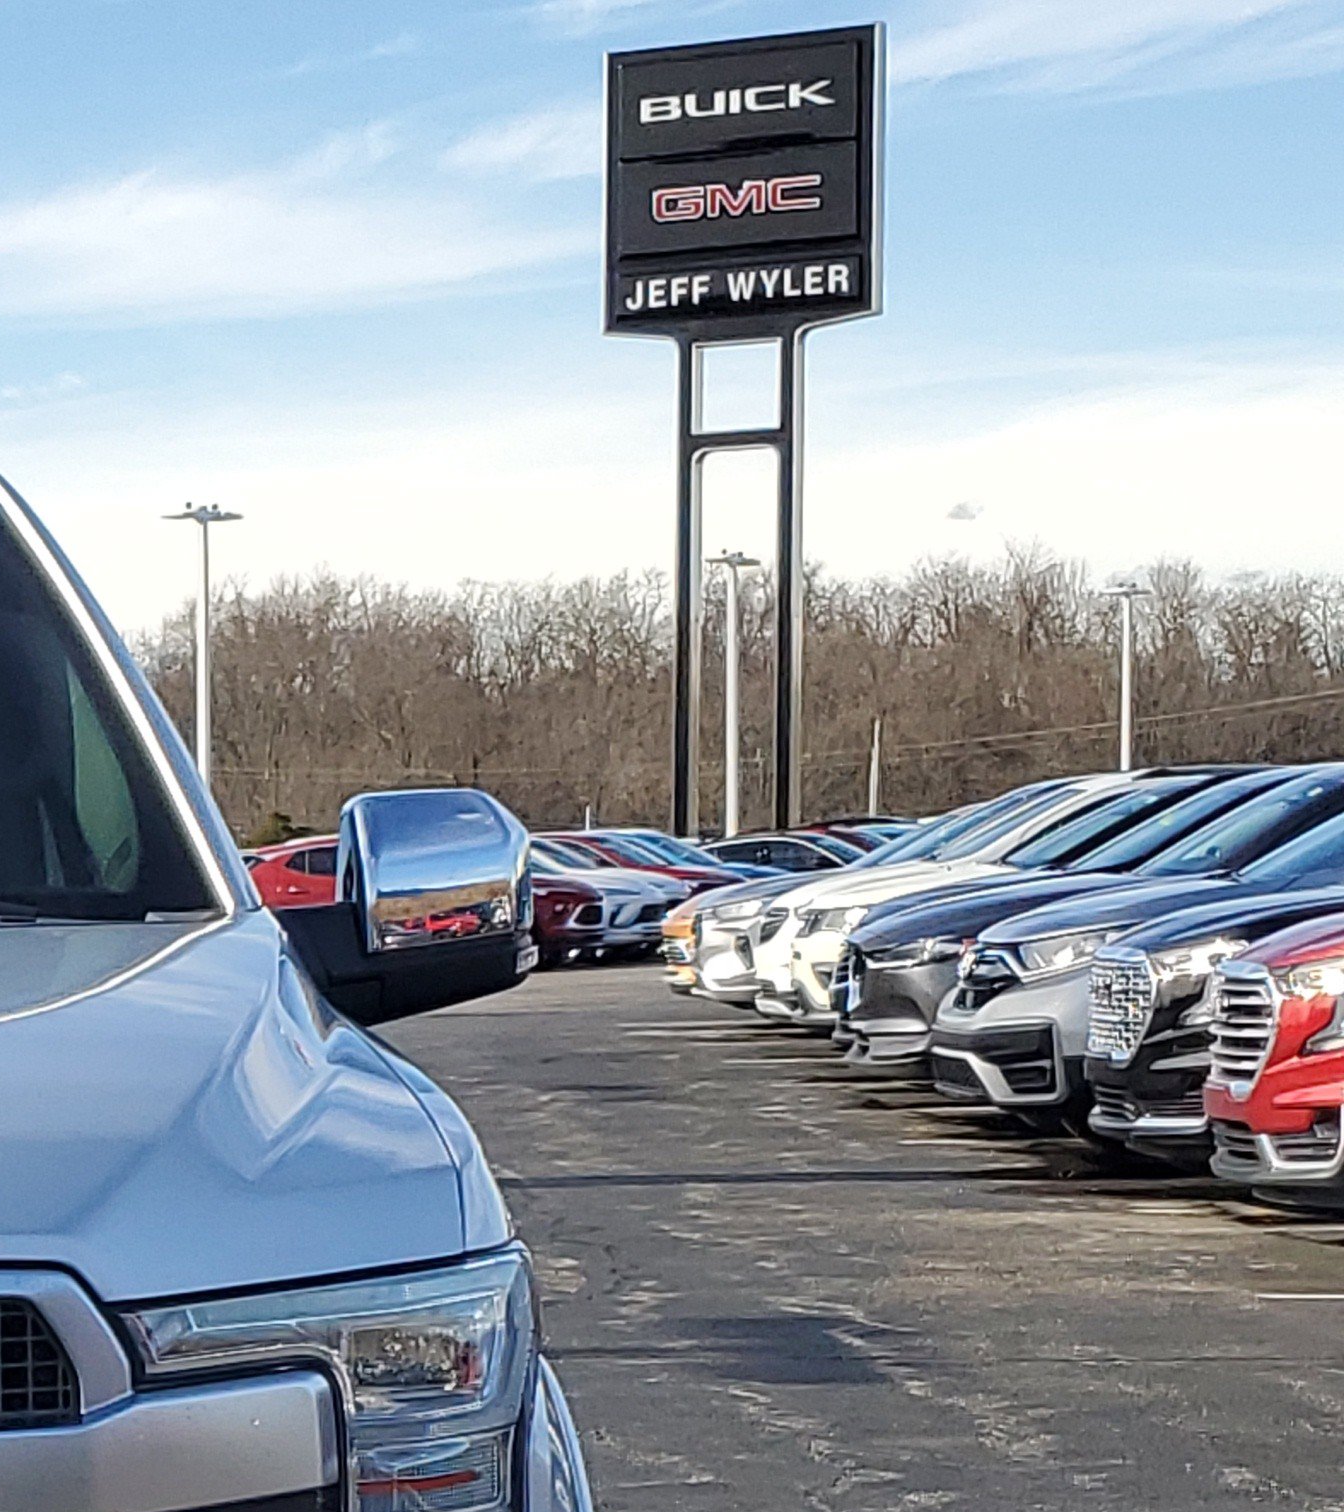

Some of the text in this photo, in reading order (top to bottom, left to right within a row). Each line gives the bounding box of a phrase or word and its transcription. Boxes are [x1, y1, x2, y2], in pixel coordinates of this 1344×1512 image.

[640, 79, 836, 124] BUICK
[652, 174, 822, 223] GMC
[625, 264, 850, 310] JEFF WYLER
